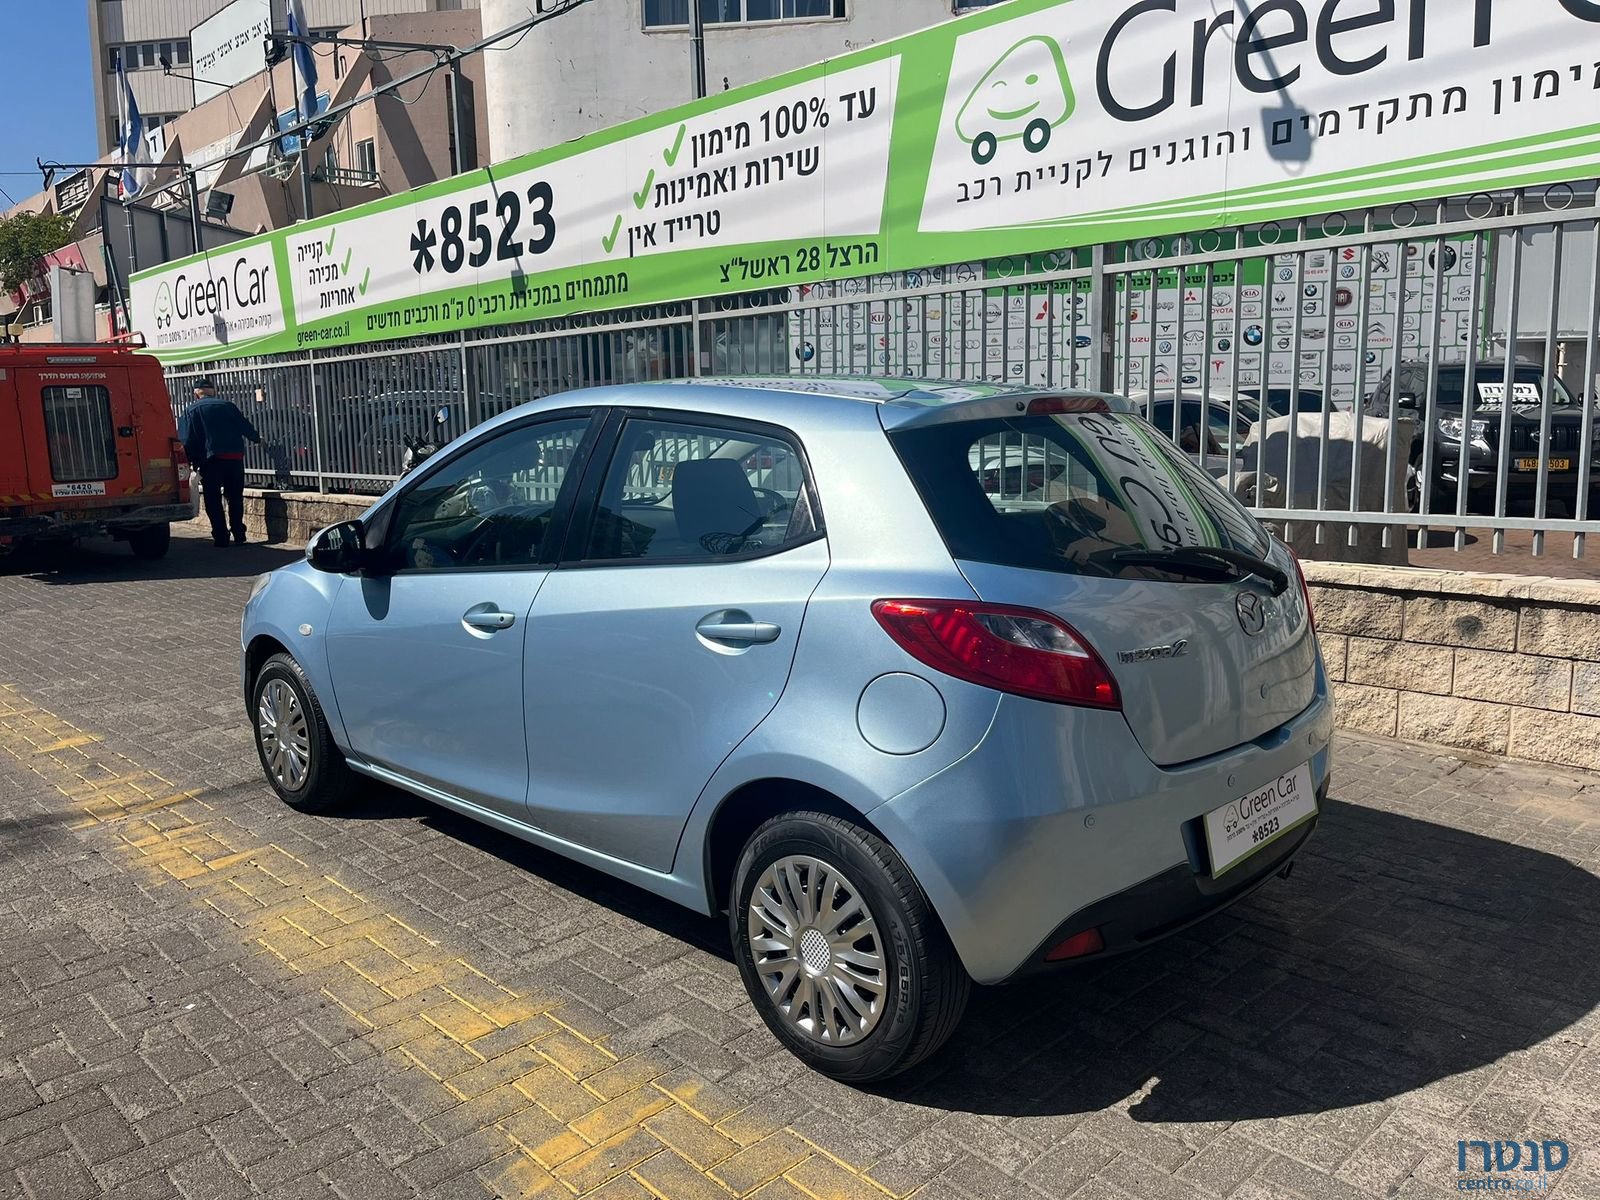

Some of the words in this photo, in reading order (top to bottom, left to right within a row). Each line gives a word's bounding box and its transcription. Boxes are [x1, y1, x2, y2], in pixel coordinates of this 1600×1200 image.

[839, 86, 876, 122] עד
[1493, 61, 1600, 115] ימון
[759, 95, 830, 143] 100%
[1271, 85, 1468, 146] מתקדמים
[690, 120, 750, 169] מימון
[1129, 126, 1251, 172] והוגנים
[744, 145, 820, 190] שירות
[1014, 149, 1113, 194] לקניית
[654, 165, 737, 209] ואמינות
[956, 175, 1002, 203] רכב
[627, 221, 657, 258] אין
[663, 209, 721, 244] טרייד
[297, 241, 323, 263] קנייה
[796, 245, 821, 273] 28
[826, 241, 879, 269] הרצל
[175, 274, 230, 320] Green
[233, 257, 269, 308] Car
[308, 263, 339, 286] מכירה
[565, 271, 629, 299] מתמחים
[320, 286, 356, 309] אחריות
[467, 296, 476, 317] 0
[478, 295, 506, 315] רכבי
[509, 282, 562, 311] במכירת
[367, 310, 400, 331] חדשים
[404, 303, 438, 326] ורכבים
[296, 320, 350, 347] green-car.co.il
[1239, 787, 1277, 820] Green
[1276, 775, 1297, 798] Car
